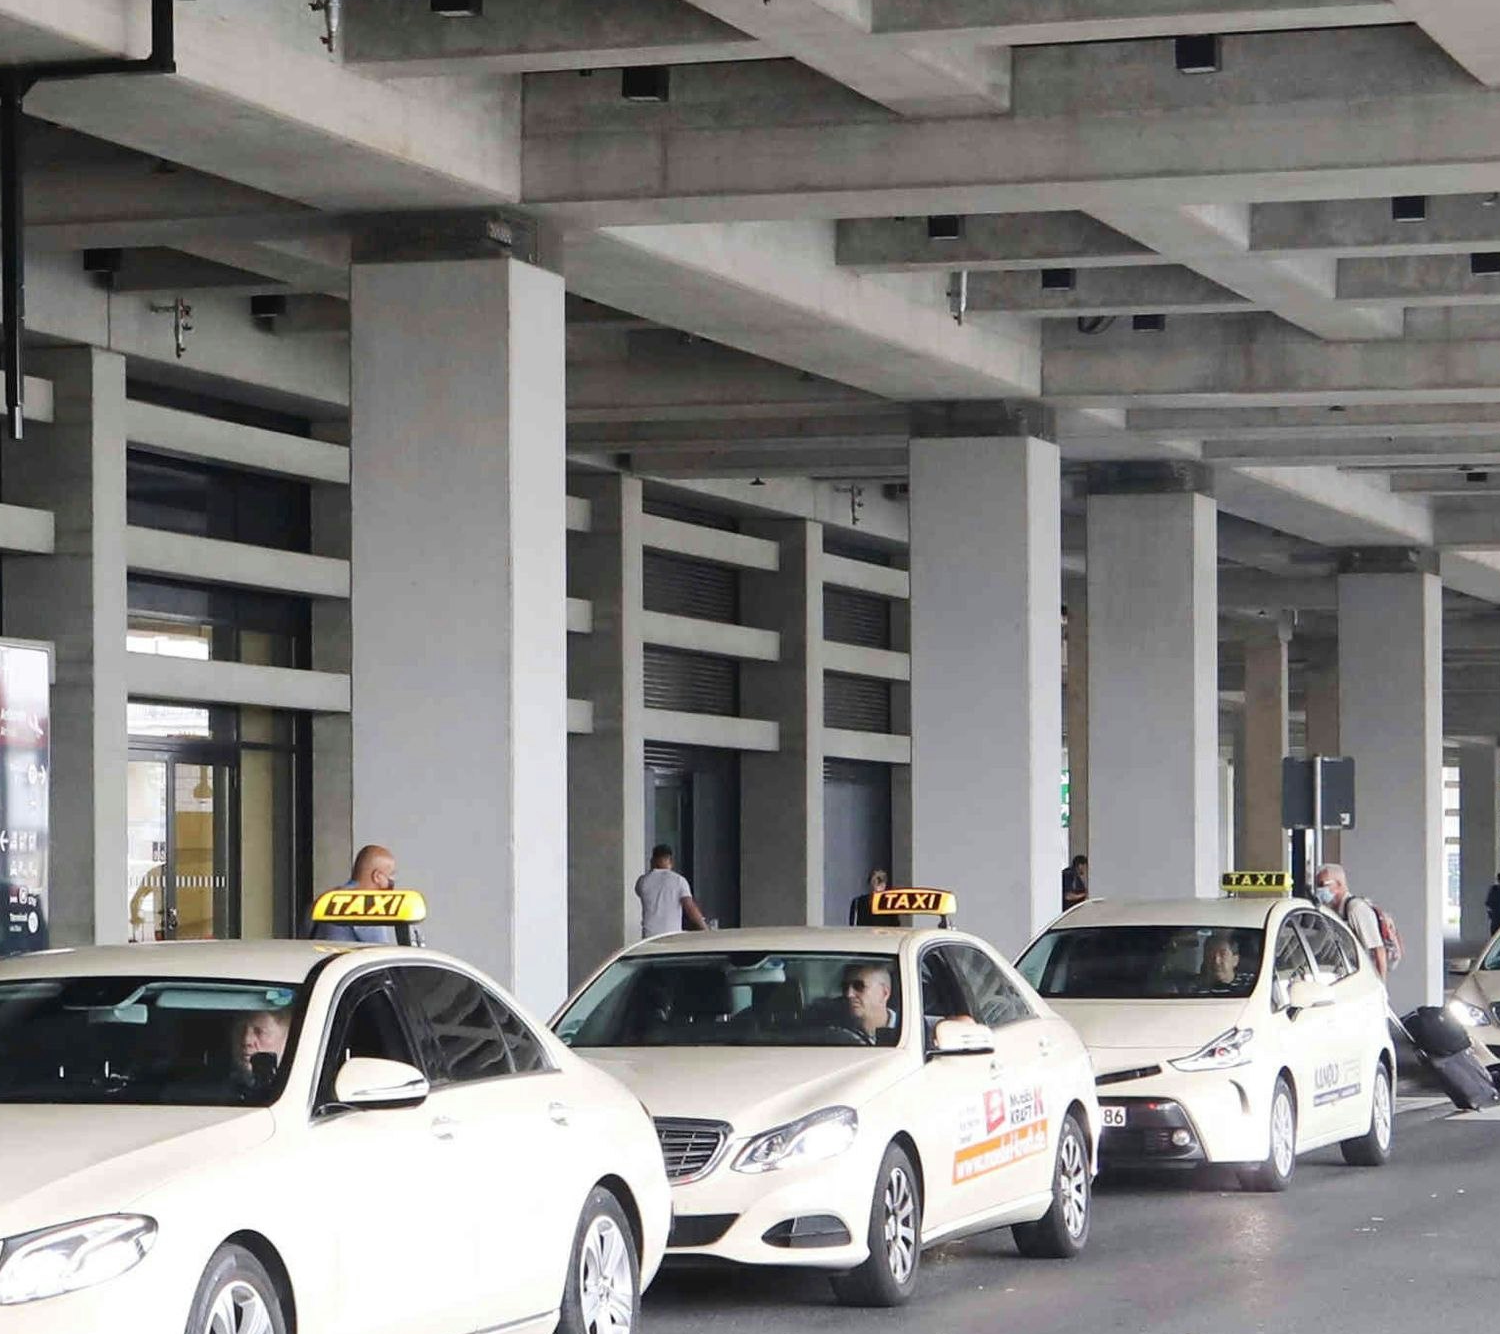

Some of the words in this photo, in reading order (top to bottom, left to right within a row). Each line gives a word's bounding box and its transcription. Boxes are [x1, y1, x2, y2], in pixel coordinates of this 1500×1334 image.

[1230, 874, 1276, 885] TAXI
[331, 895, 403, 916] TAXI
[885, 894, 936, 909] TAXI
[1103, 1108, 1124, 1124] 86
